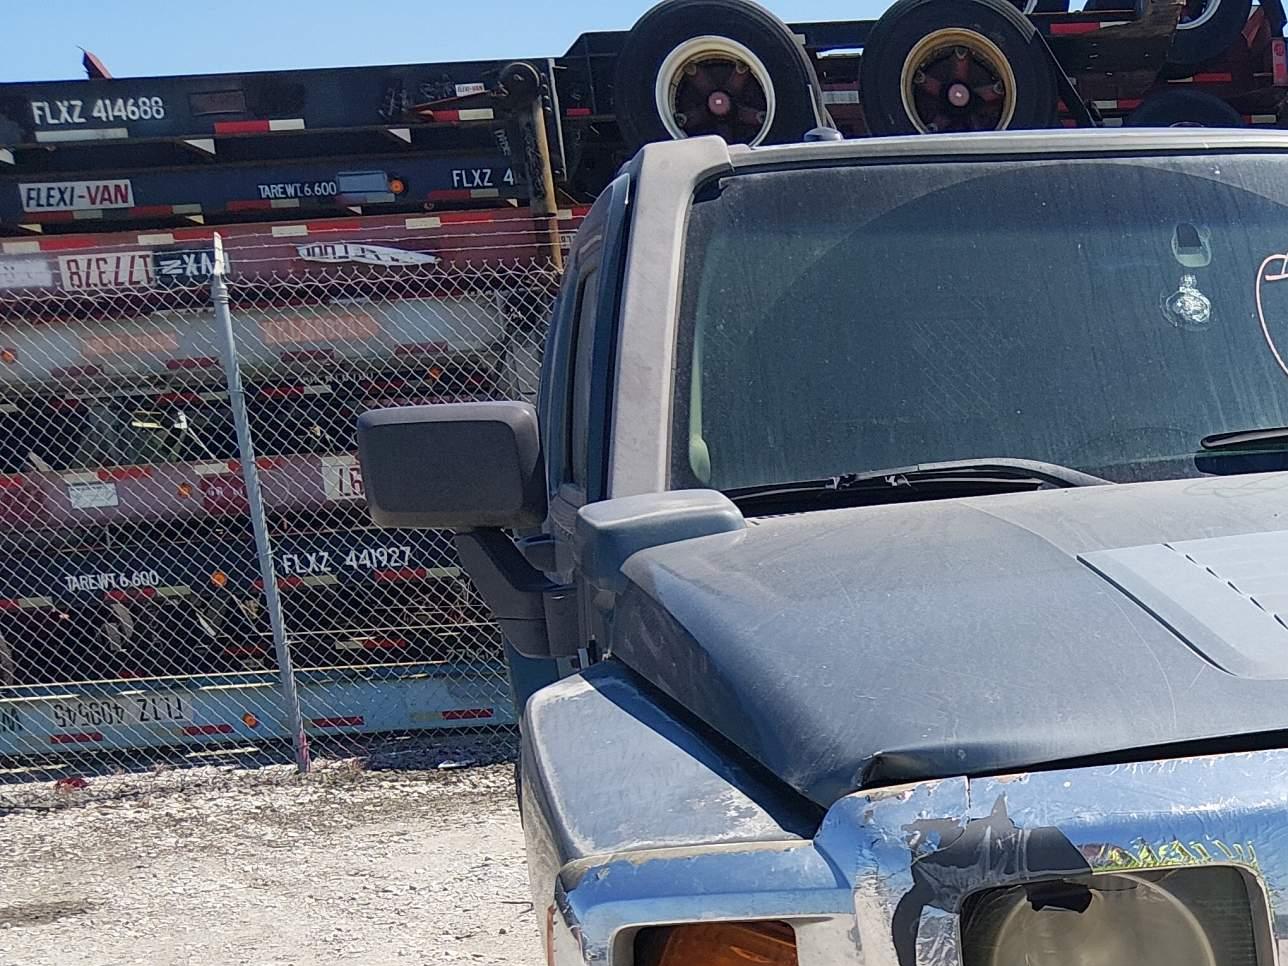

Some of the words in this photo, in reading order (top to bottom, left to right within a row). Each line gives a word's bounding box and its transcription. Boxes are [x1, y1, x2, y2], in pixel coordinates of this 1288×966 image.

[31, 100, 87, 125] FLXZ
[92, 96, 165, 121] 414688
[452, 168, 493, 189] FLXZ
[25, 183, 129, 208] FLEXI-VAN
[66, 254, 152, 289] 177378
[282, 551, 332, 574] FLXZ
[345, 546, 412, 570] 441927
[136, 697, 185, 723] FLTZ
